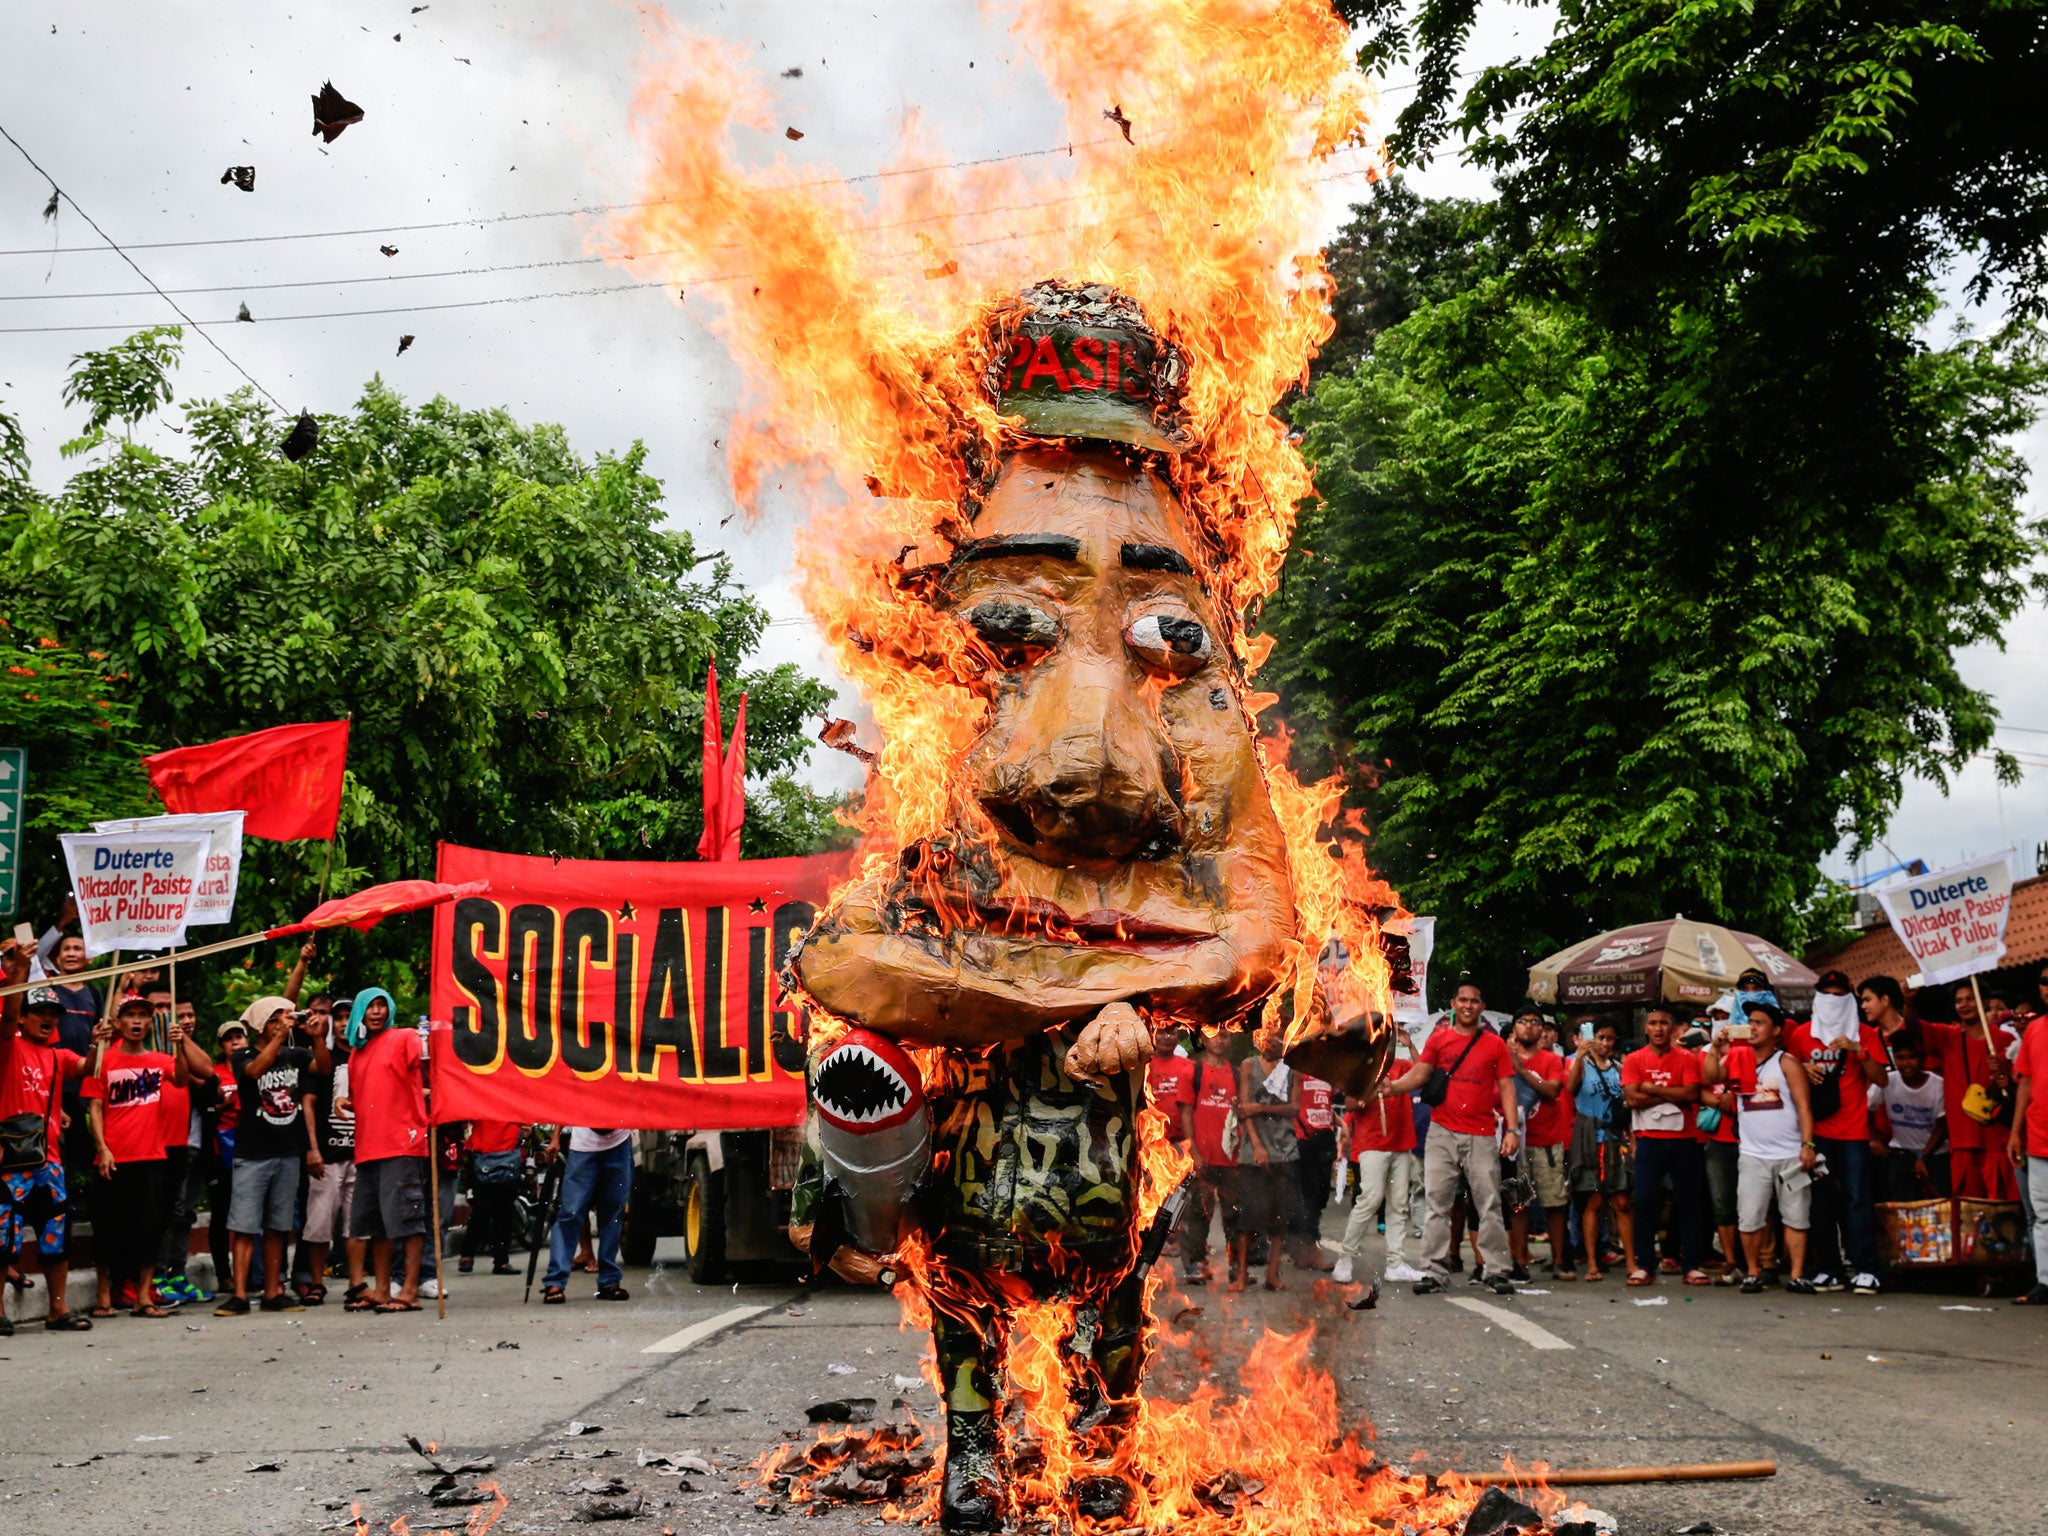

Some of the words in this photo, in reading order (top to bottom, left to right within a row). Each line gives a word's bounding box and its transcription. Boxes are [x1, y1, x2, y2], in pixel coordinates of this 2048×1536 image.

[94, 847, 174, 871] Duterte
[78, 873, 138, 901] Diktador,
[141, 872, 192, 895] Pasista
[1909, 876, 1989, 911] Duterte
[115, 896, 188, 921] Pulbura!
[1900, 906, 1968, 939] Diktador,
[1910, 932, 1951, 960] Utak
[1568, 985, 1616, 996] KOPIKO
[1680, 985, 1711, 995] KOPIKO
